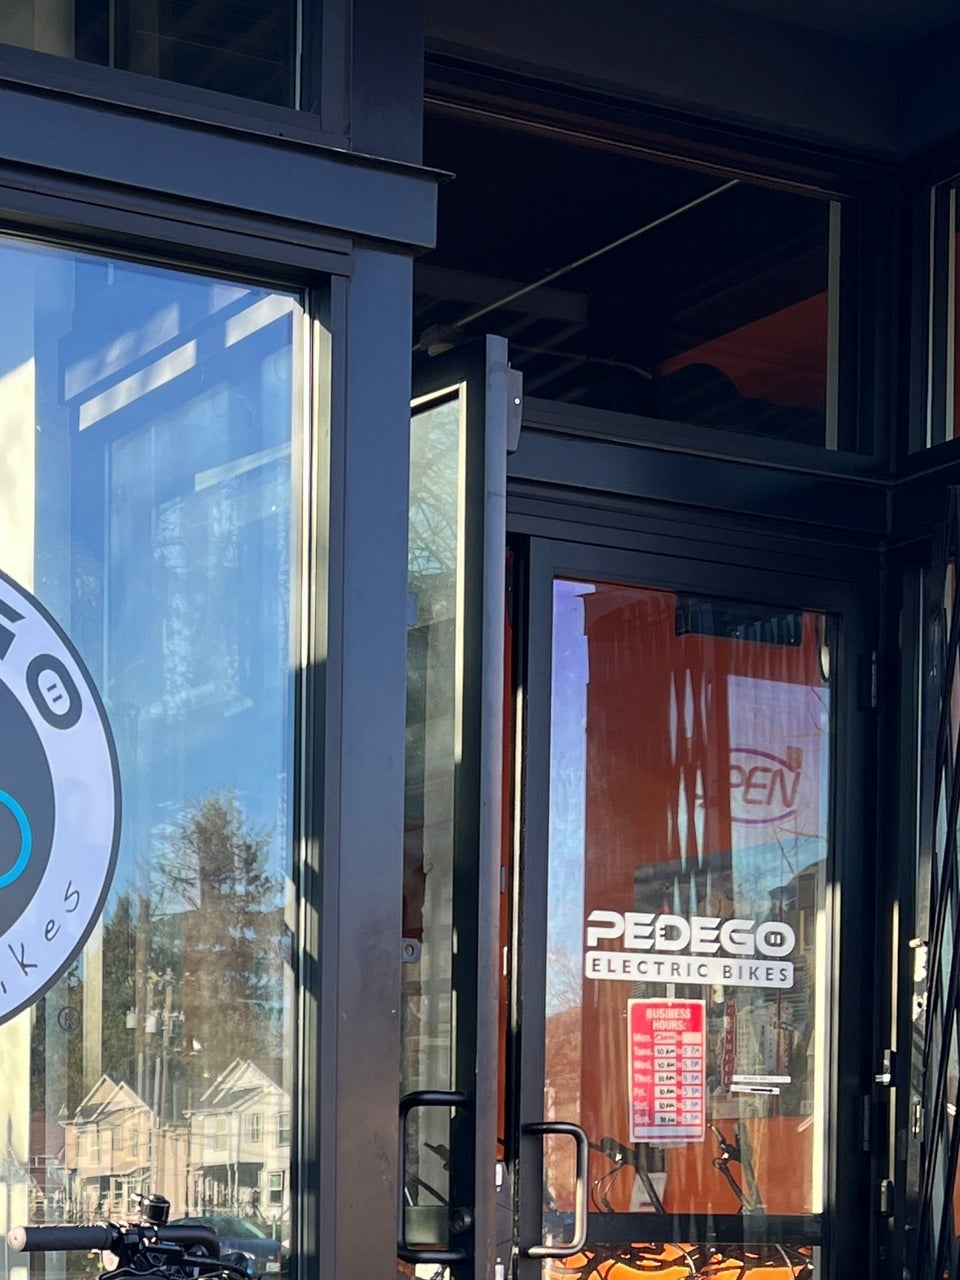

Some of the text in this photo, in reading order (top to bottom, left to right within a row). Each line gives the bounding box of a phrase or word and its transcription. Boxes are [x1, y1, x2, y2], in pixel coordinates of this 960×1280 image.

[730, 765, 801, 808] PEN
[587, 910, 795, 957] PEDEGO
[592, 958, 788, 982] ELECTRIC BIKES
[645, 1008, 691, 1019] BUSINESS
[652, 1020, 687, 1030] HOURS:
